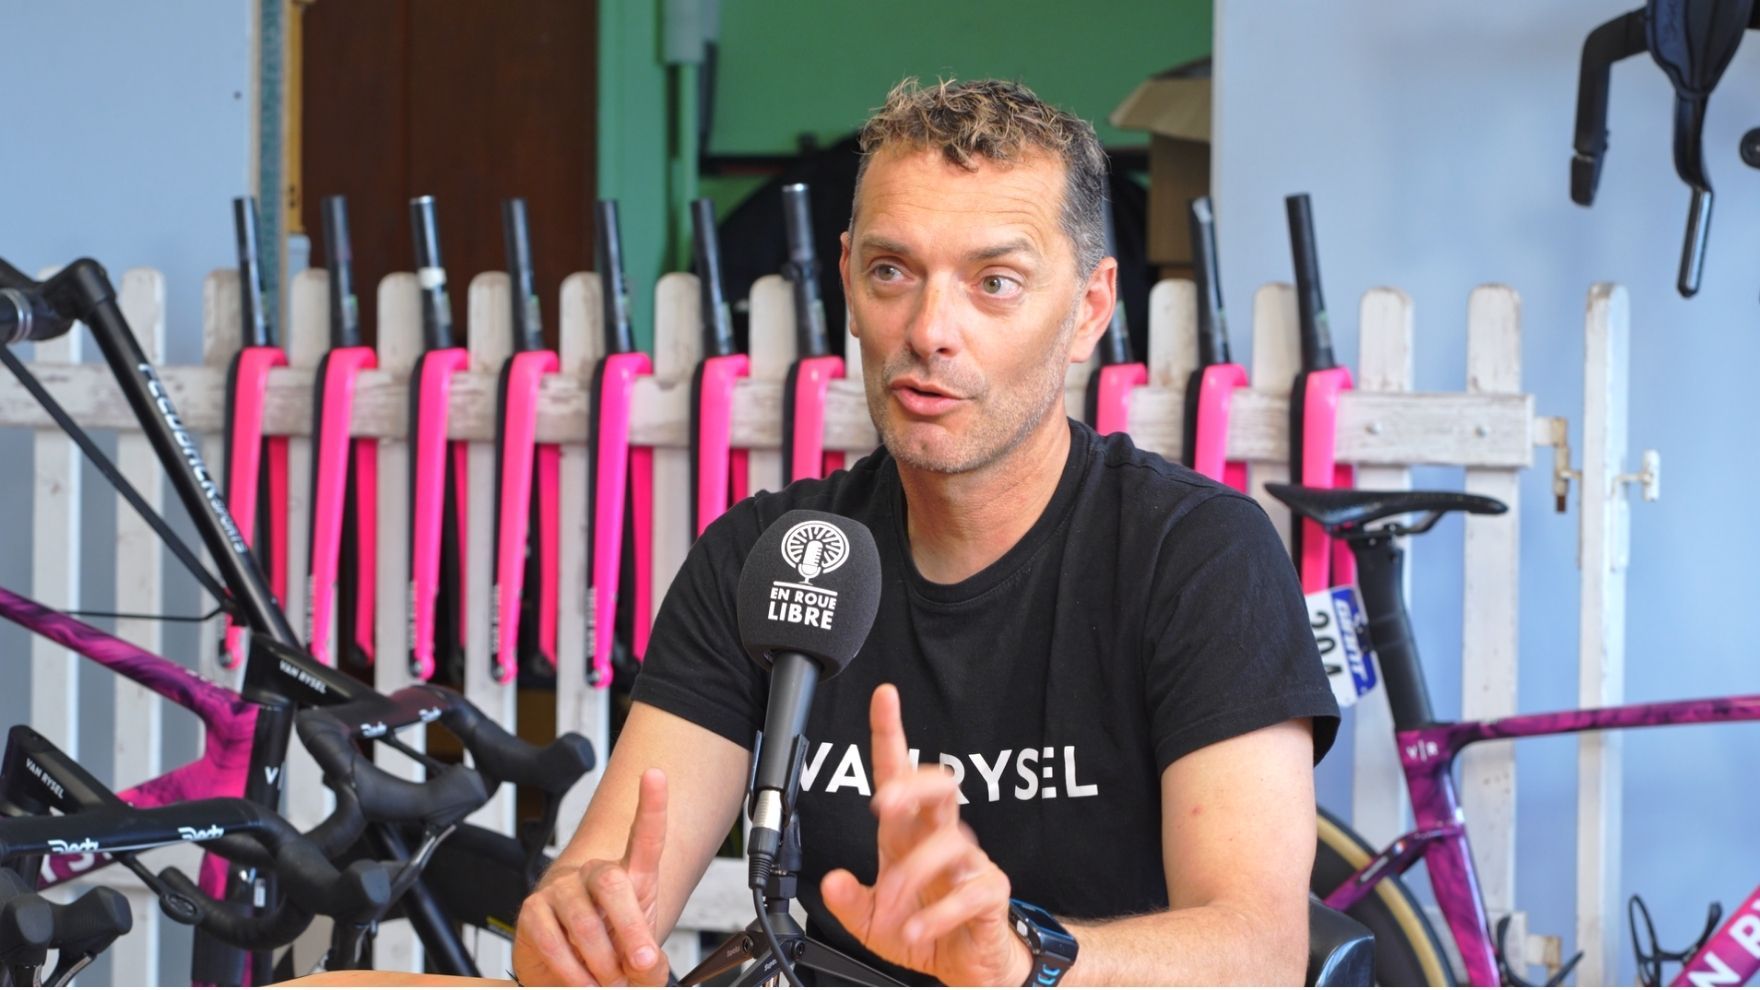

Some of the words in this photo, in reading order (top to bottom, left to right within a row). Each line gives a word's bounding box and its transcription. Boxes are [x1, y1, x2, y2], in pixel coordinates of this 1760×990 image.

[770, 587, 790, 601] EN
[794, 590, 837, 610] ROUE
[768, 600, 834, 630] LIBRE
[279, 659, 299, 679] VAN
[299, 670, 327, 694] RYSEL
[25, 757, 41, 778] VAN
[40, 771, 65, 799] RYSEL
